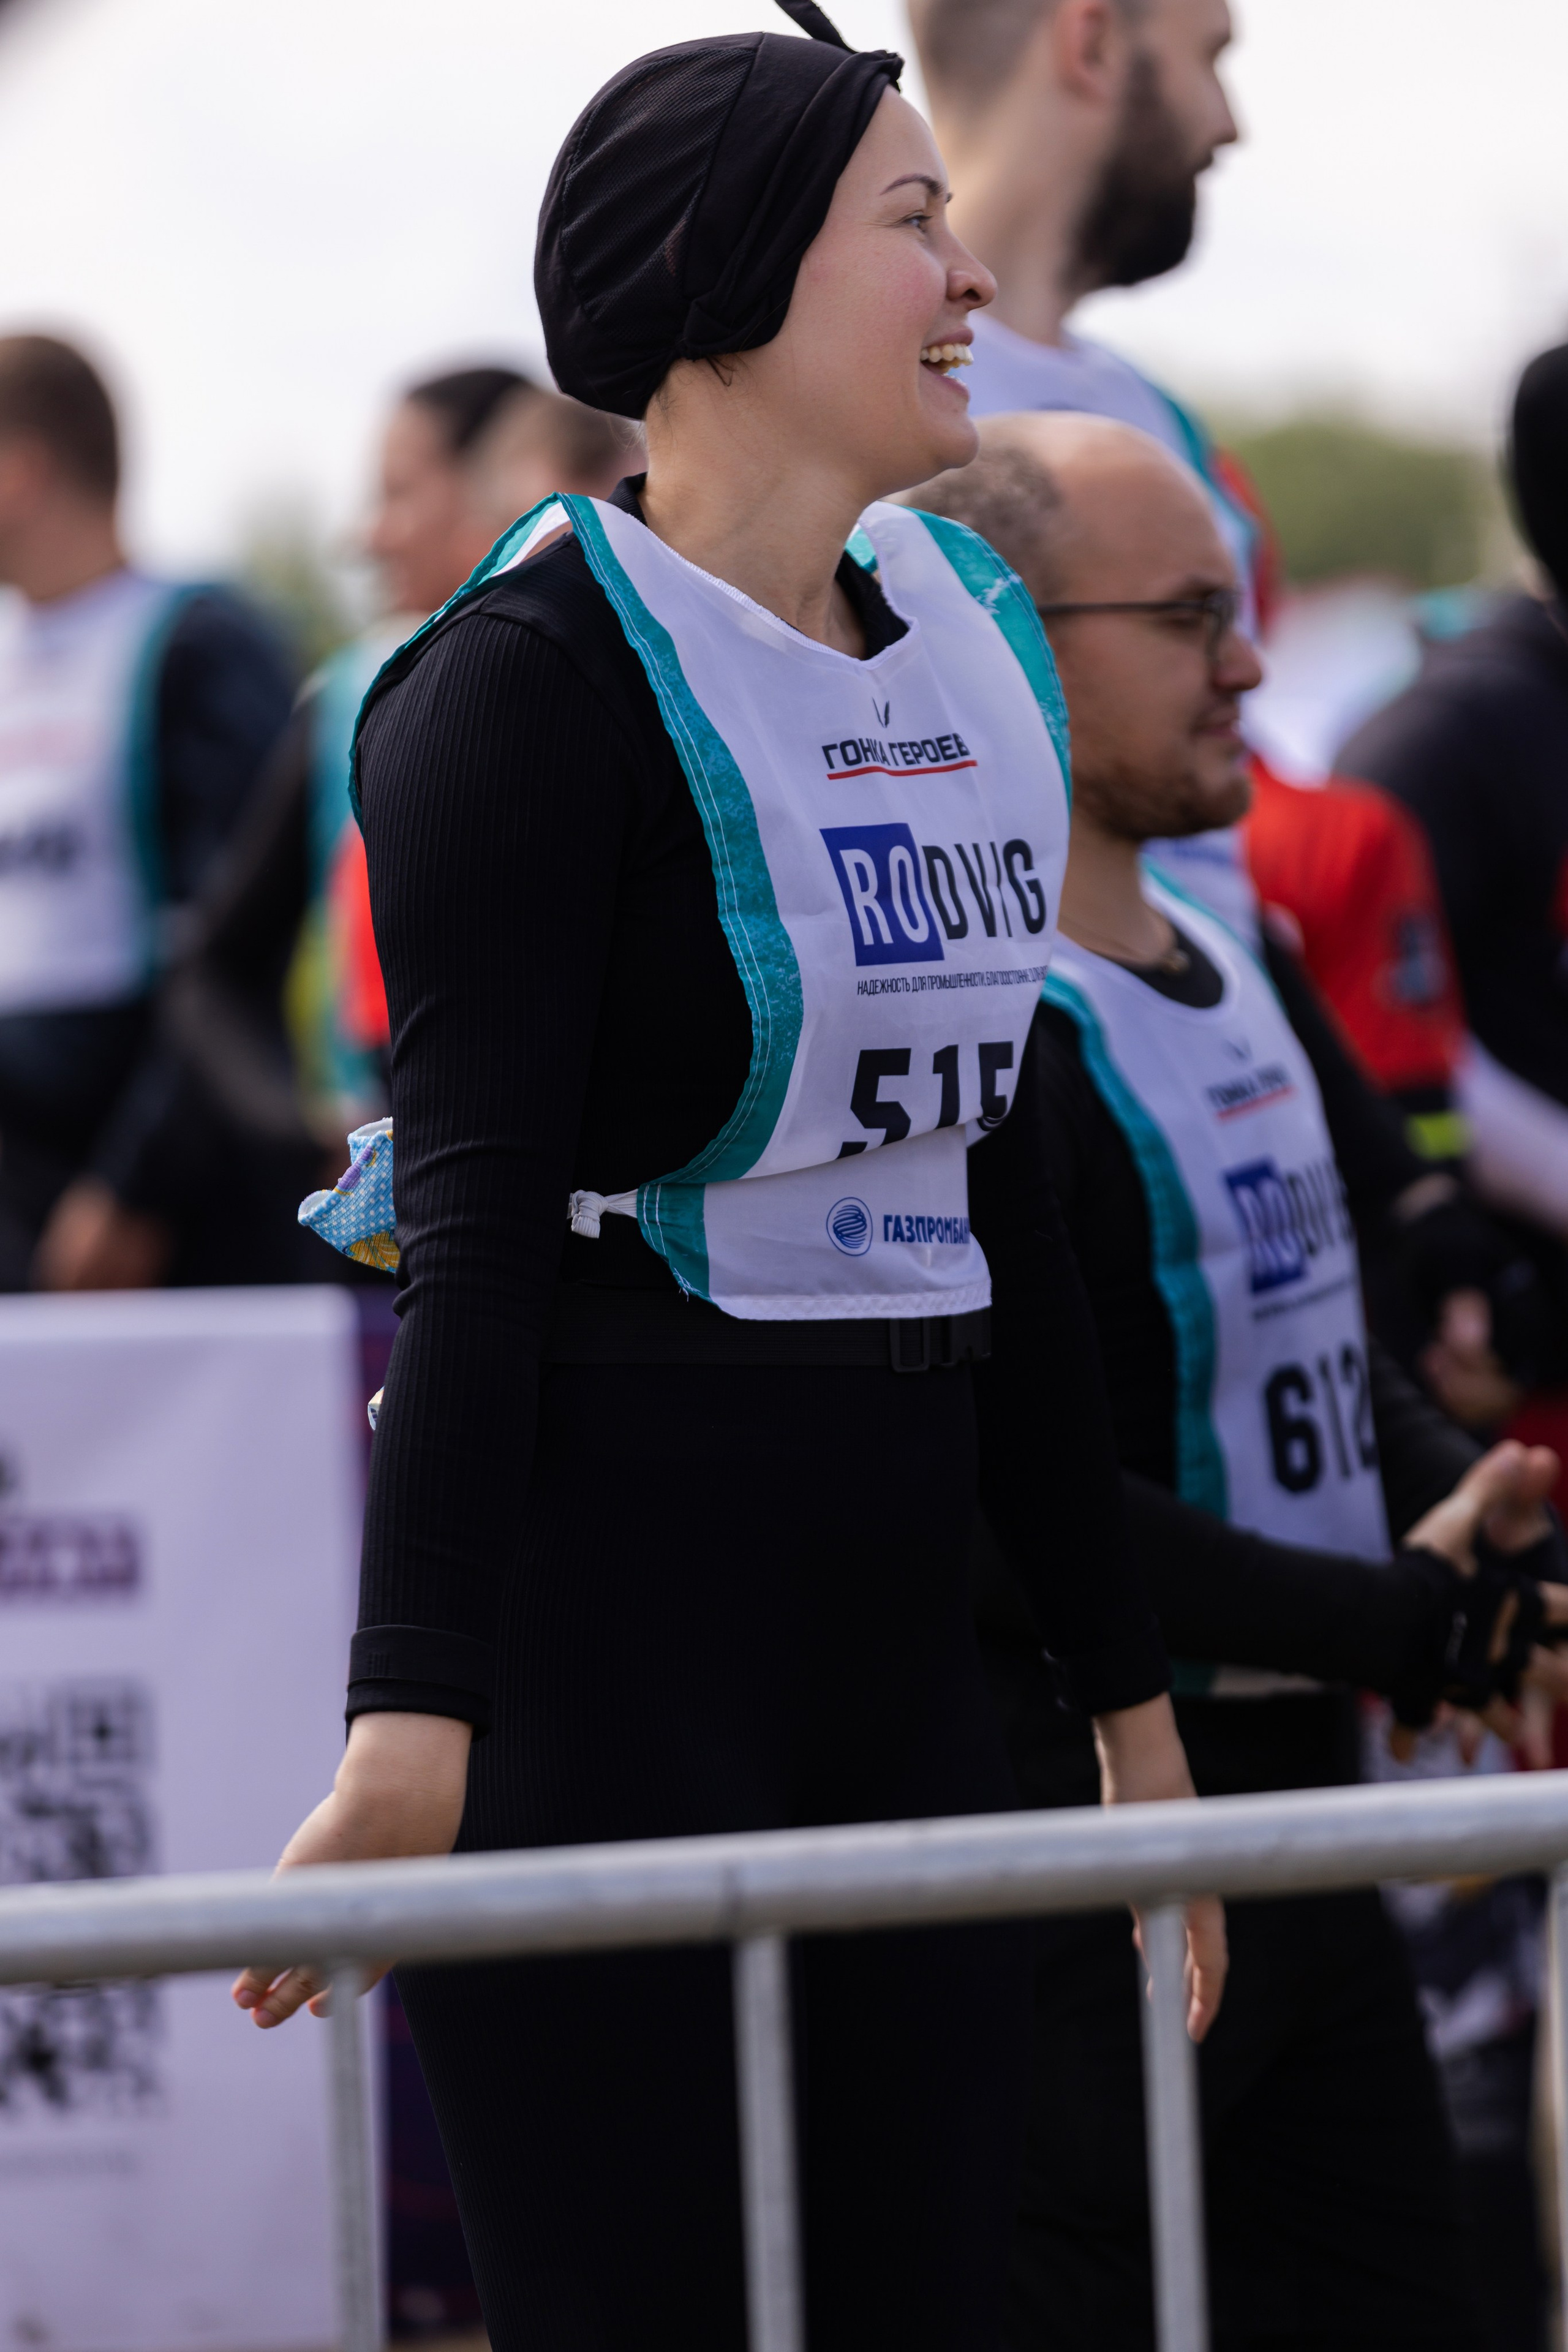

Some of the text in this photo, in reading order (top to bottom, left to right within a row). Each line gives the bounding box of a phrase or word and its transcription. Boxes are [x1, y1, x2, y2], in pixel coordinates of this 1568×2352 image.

[821, 733, 971, 770] ГОНКА ГЕРОЕВ
[839, 838, 1047, 946] RODVIG
[857, 976, 910, 995] НАДЕЖНОСТЬ
[911, 974, 927, 992] ДЛЯ
[836, 1041, 1014, 1159] 515
[1265, 1343, 1378, 1493] 612
